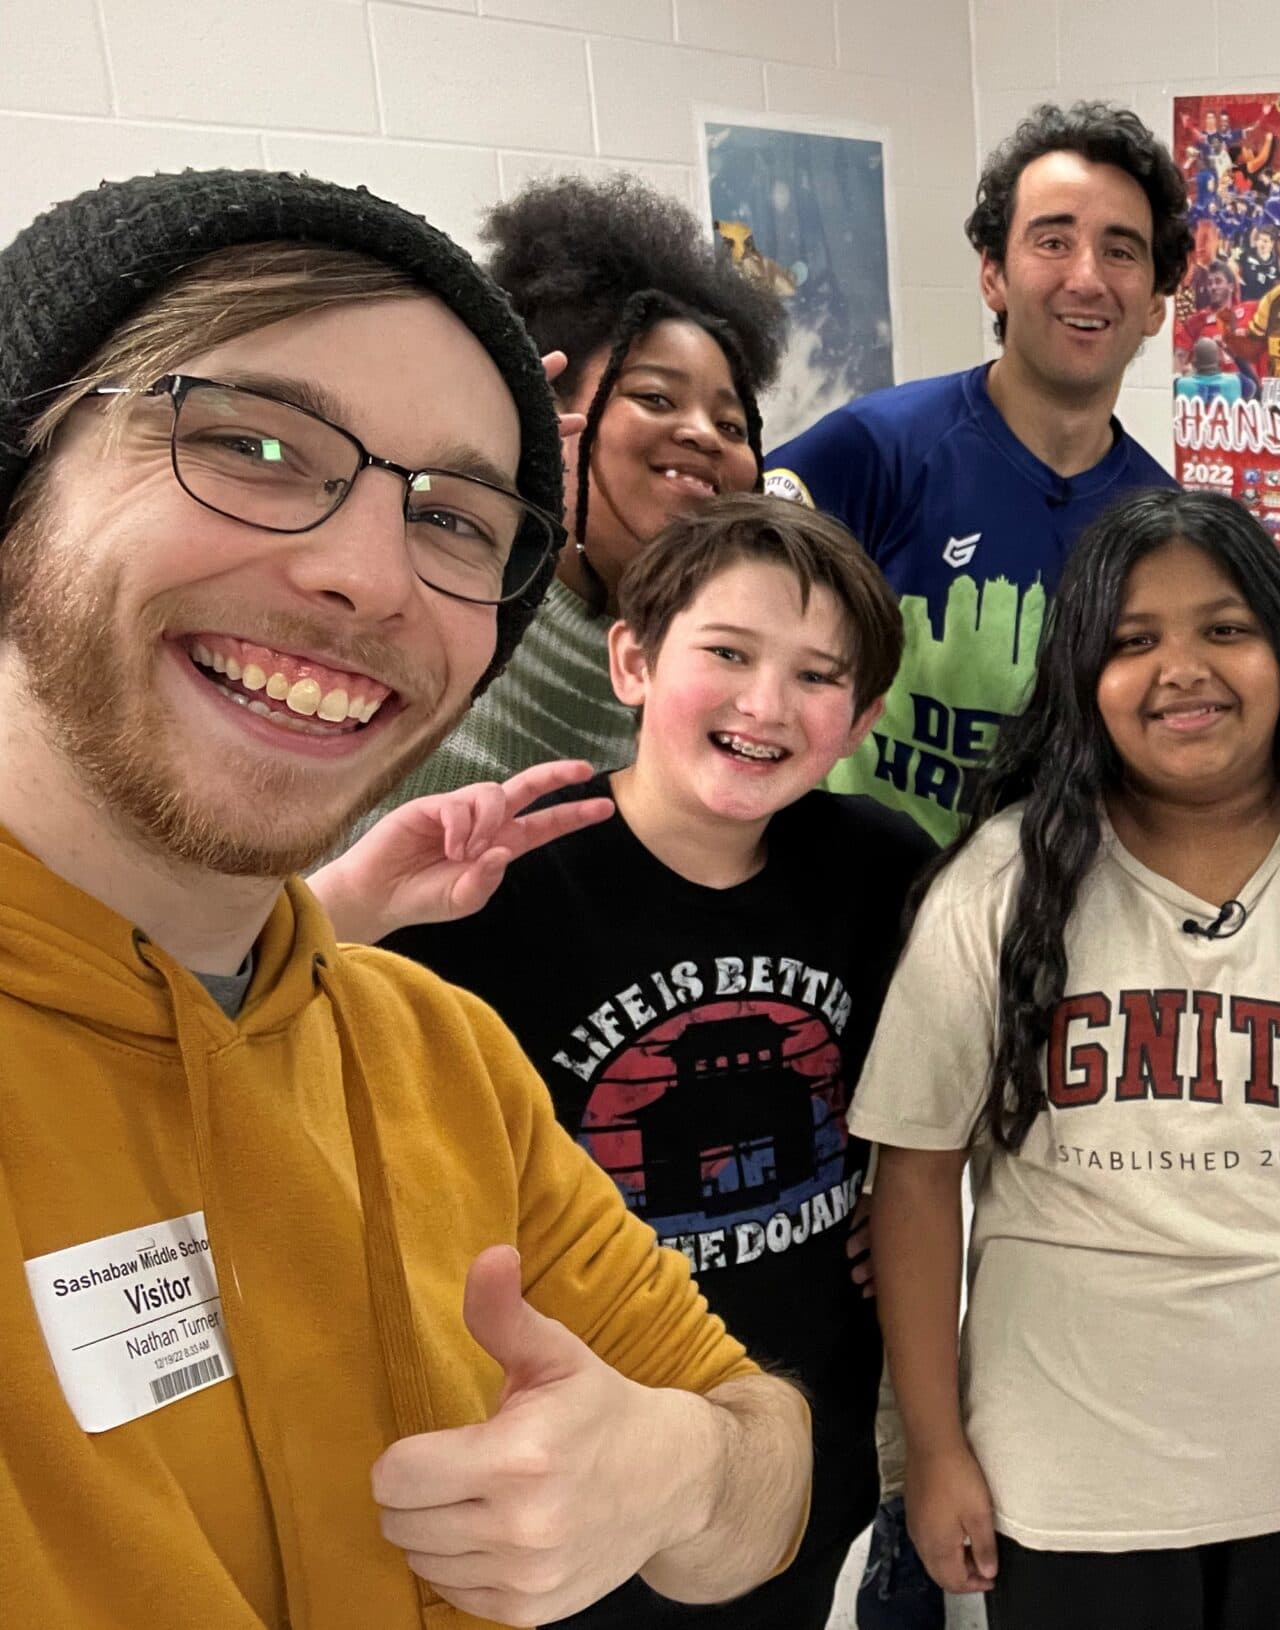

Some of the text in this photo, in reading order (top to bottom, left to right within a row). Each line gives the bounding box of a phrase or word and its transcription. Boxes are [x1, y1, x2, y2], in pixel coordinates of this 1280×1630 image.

[1183, 463, 1234, 486] 2022
[551, 956, 852, 1083] LIFE IS BETTER
[1058, 1144, 1241, 1171] STABLISHED
[53, 1238, 209, 1297] Sashabaw Middle Scho
[124, 1275, 193, 1315] Visitor
[126, 1311, 220, 1360] Nathan Turner
